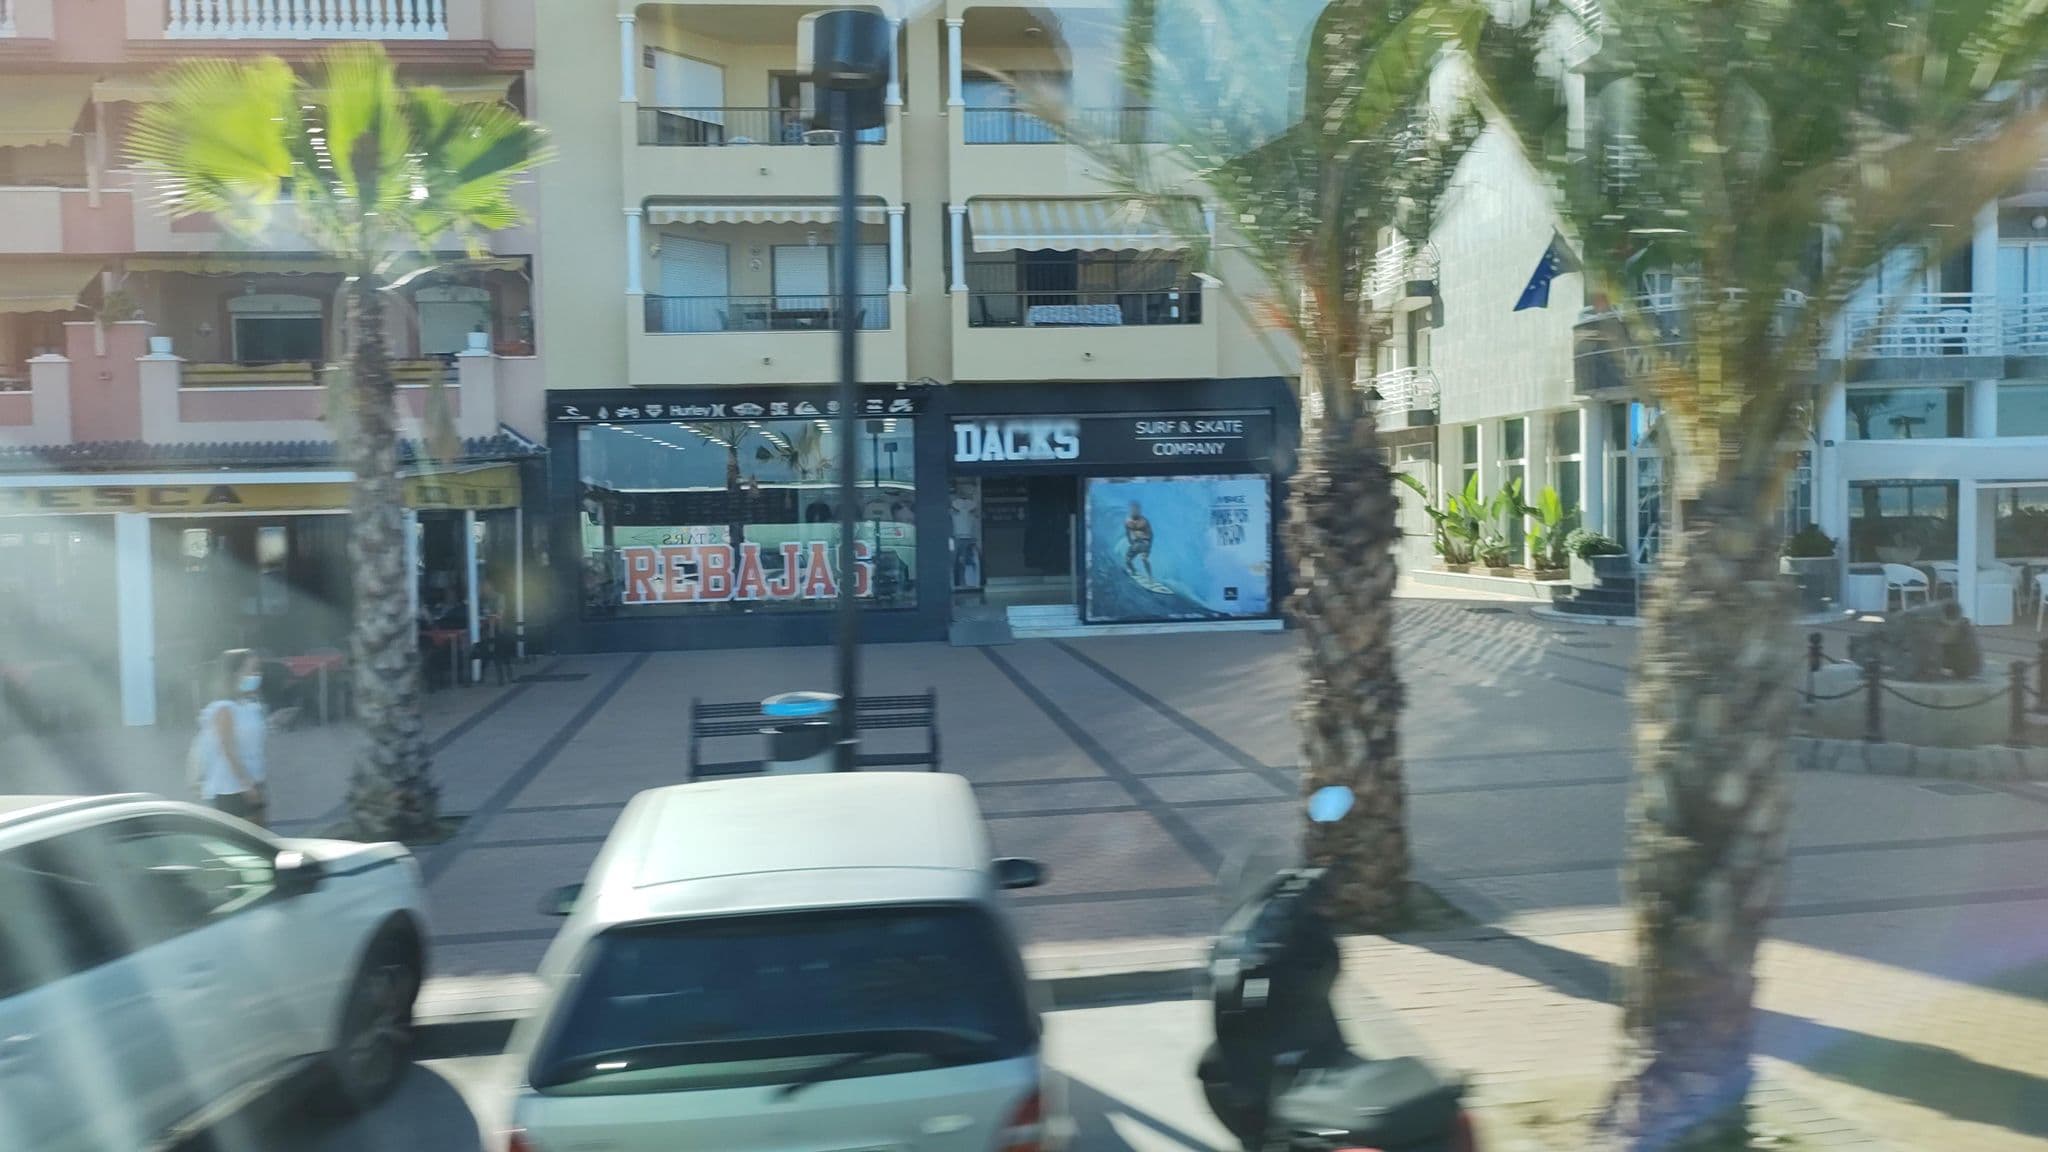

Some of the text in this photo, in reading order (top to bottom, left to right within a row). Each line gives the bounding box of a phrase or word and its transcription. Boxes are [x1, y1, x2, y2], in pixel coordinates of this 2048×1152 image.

[669, 404, 711, 416] Hurley
[1135, 420, 1243, 434] SURF & SKATE
[953, 420, 1080, 462] DACKS
[1152, 442, 1226, 456] COMPANY
[622, 540, 873, 604] REBAJAS
